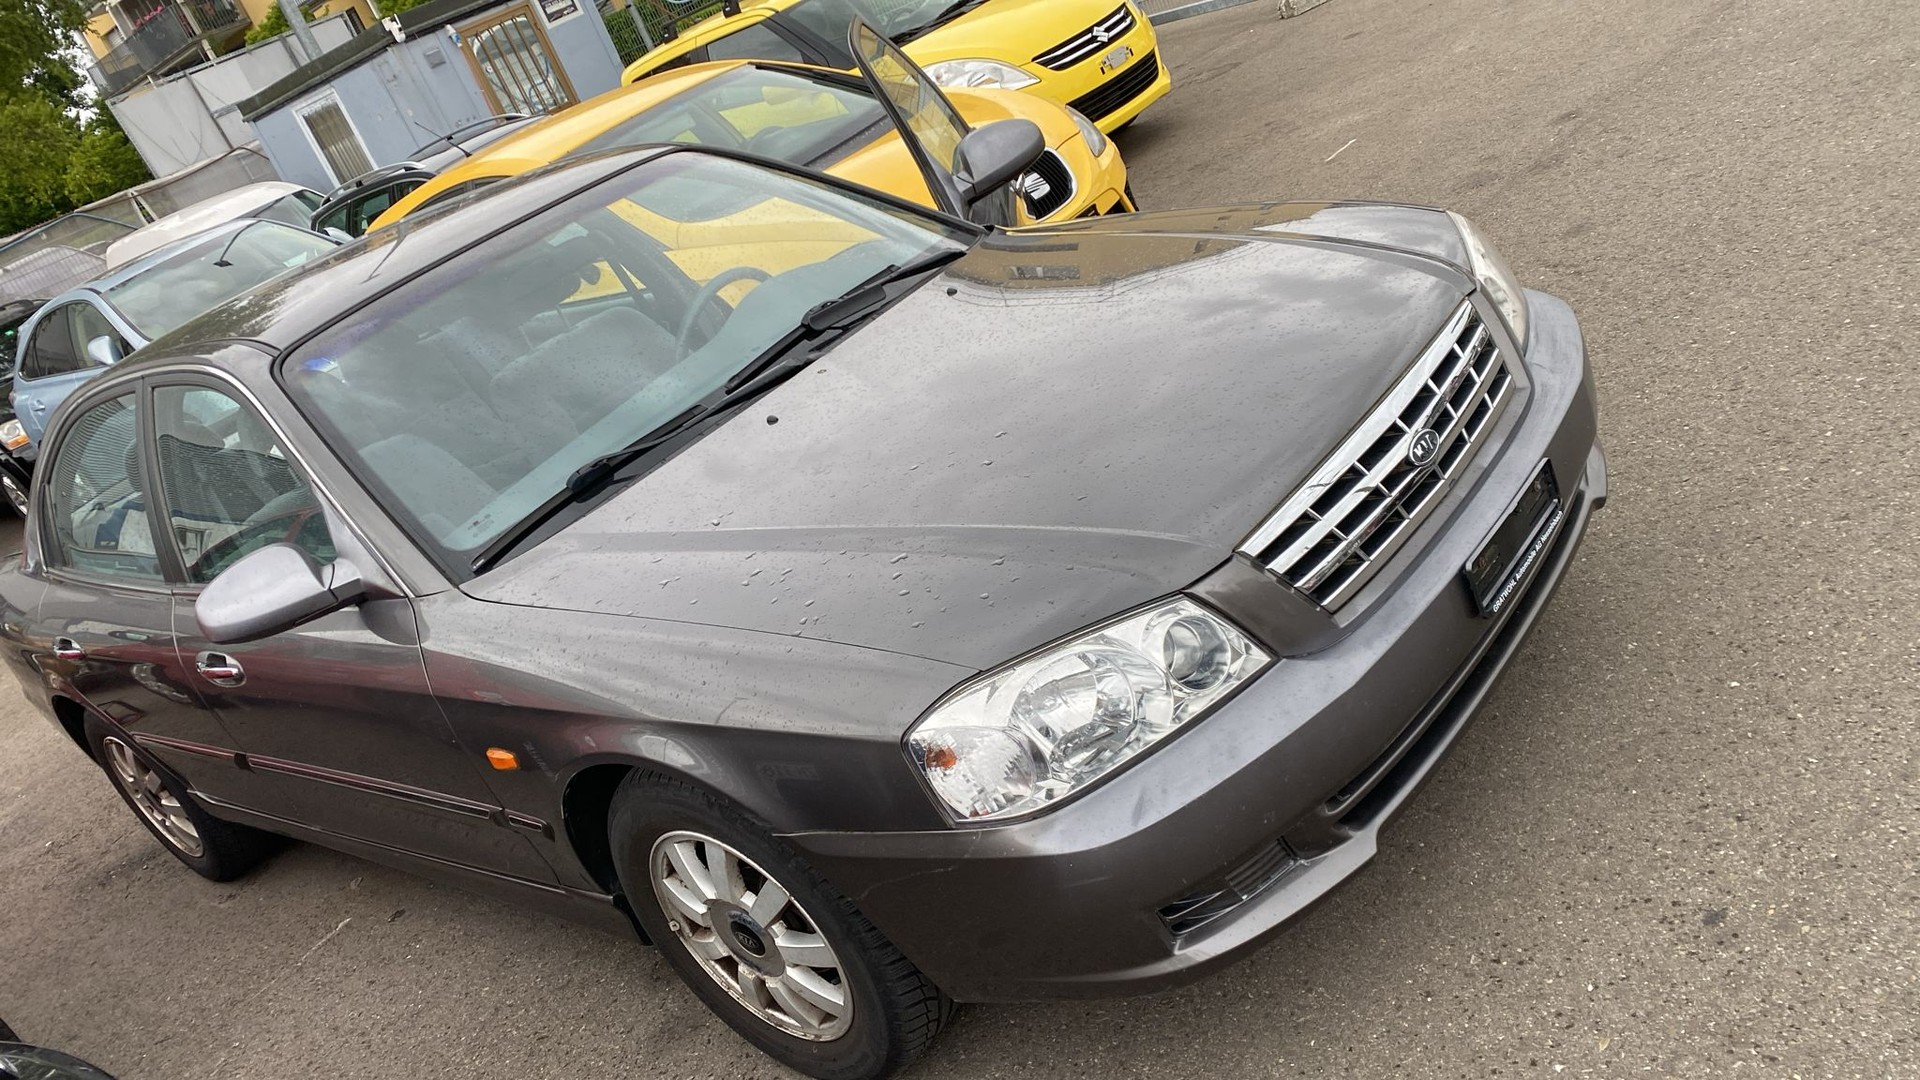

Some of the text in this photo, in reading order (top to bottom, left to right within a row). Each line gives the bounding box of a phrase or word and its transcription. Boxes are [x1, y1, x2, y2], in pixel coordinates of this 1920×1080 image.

[1515, 550, 1537, 581] Automobile
[1535, 541, 1542, 552] AG
[736, 933, 757, 948] KIA
